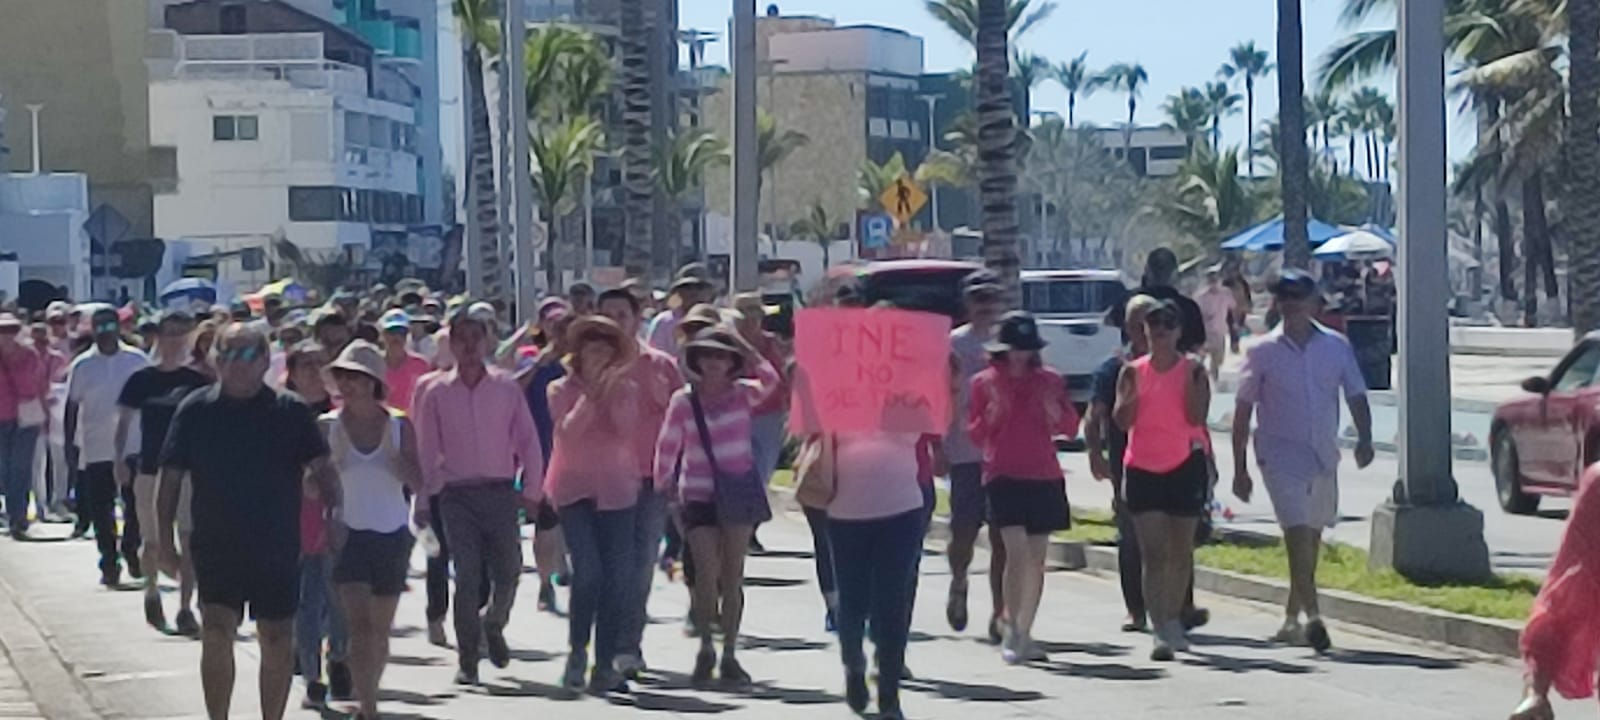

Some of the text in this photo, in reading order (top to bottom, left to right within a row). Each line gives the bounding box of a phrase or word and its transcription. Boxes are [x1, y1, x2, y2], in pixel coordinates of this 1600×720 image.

[831, 322, 918, 363] INE
[857, 362, 893, 385] NO
[824, 387, 861, 410] SE
